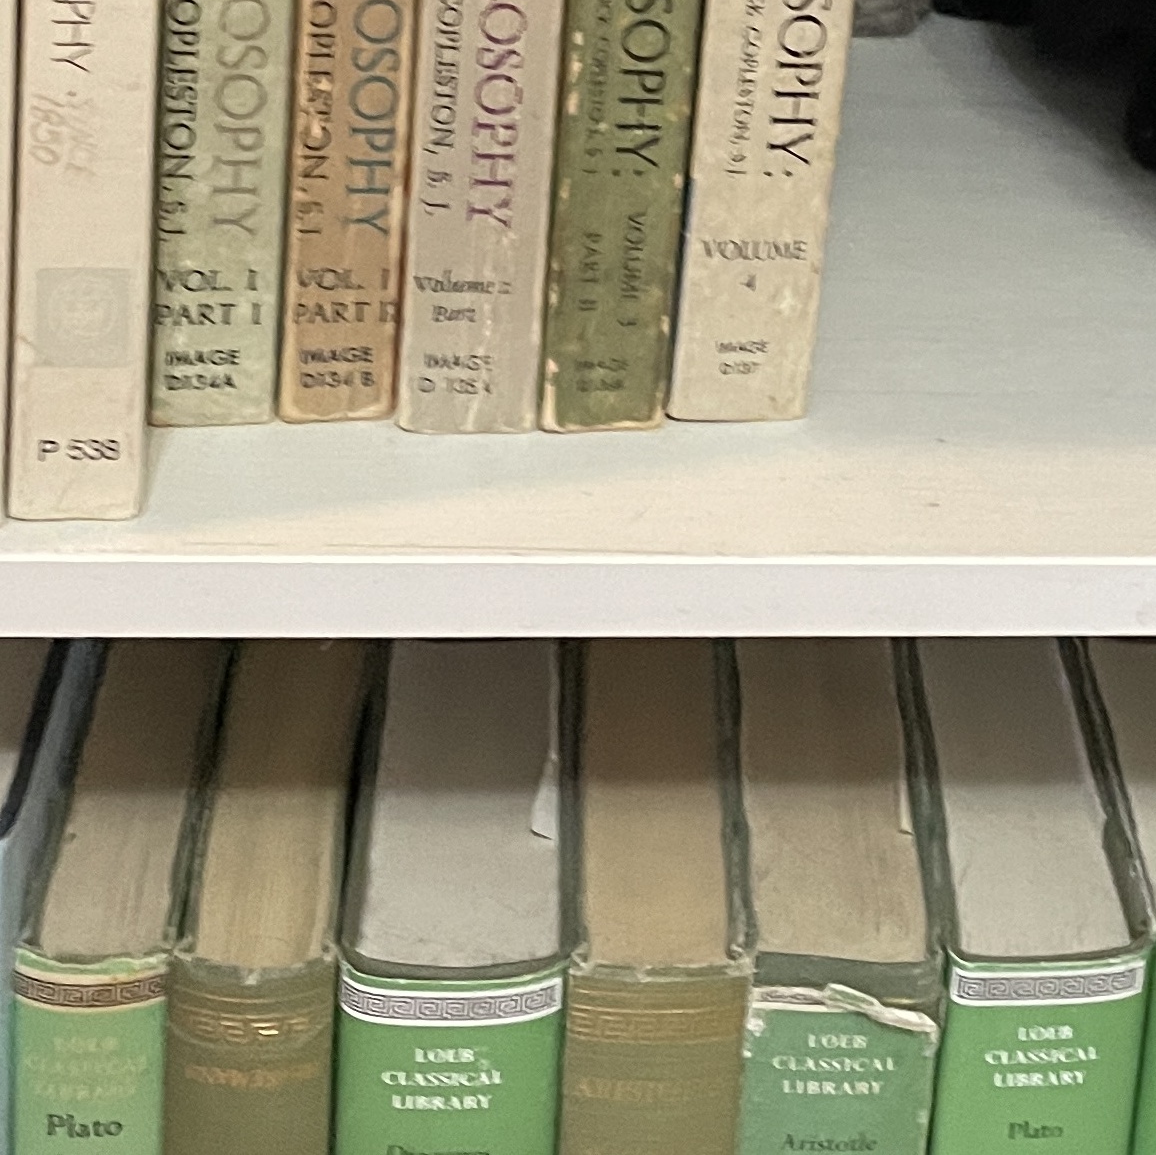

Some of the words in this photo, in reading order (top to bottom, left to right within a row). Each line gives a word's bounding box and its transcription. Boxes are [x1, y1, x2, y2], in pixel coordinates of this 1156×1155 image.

[701, 239, 807, 261] VOLUME
[247, 268, 258, 292] I
[155, 302, 237, 326] PART
[251, 302, 262, 325] I
[293, 301, 372, 325] PART
[164, 348, 241, 366] IMAGE
[300, 346, 374, 365] IMAGE
[37, 439, 60, 462] P
[772, 1055, 895, 1071] CLASSICAL
[984, 1046, 1099, 1065] CLASSICAL
[381, 1070, 502, 1086] CLASSICAL
[782, 1079, 885, 1095] LIBRARY
[993, 1070, 1086, 1088] LIBRARY
[391, 1094, 493, 1110] LIBRARY
[47, 1113, 124, 1138] Plato
[1007, 1120, 1064, 1140] Plato
